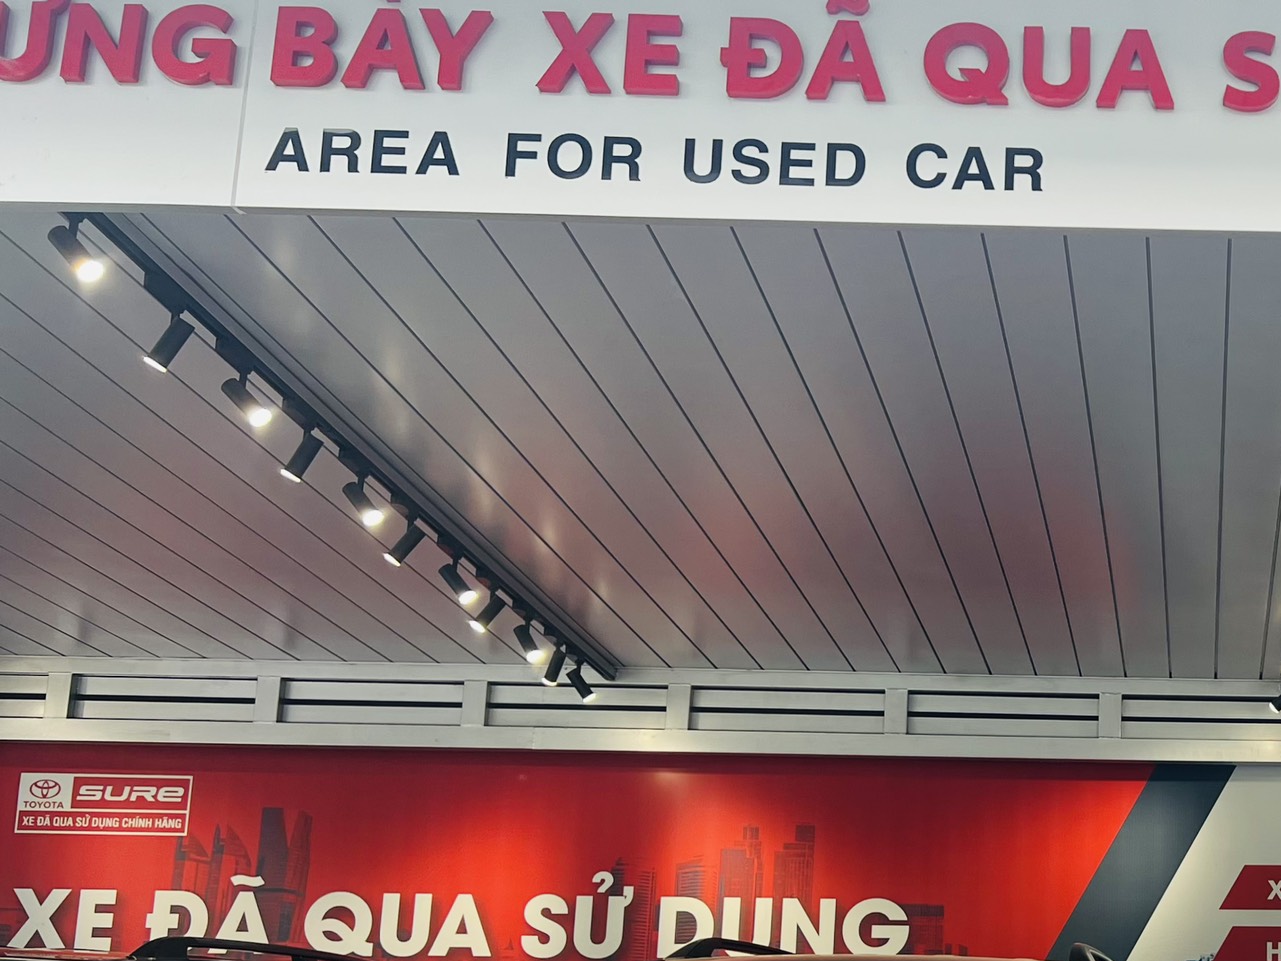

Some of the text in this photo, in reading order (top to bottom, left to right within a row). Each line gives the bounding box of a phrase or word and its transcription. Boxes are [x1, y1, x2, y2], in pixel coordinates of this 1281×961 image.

[536, 10, 684, 97] XE
[721, 0, 886, 102] ĐÃ
[923, 21, 1175, 110] QUA
[264, 127, 1044, 192] AREA FOR USED CAR
[22, 816, 34, 826] XE
[37, 814, 50, 827] ĐÃ
[53, 817, 73, 827] QUA
[75, 814, 91, 827] SỬ
[92, 817, 119, 829] DỤNG
[122, 815, 151, 828] CHÍNH
[24, 801, 64, 809] TOYOTA
[6, 888, 118, 954] XE
[304, 891, 493, 958] QUA
[521, 871, 634, 961] SỬ
